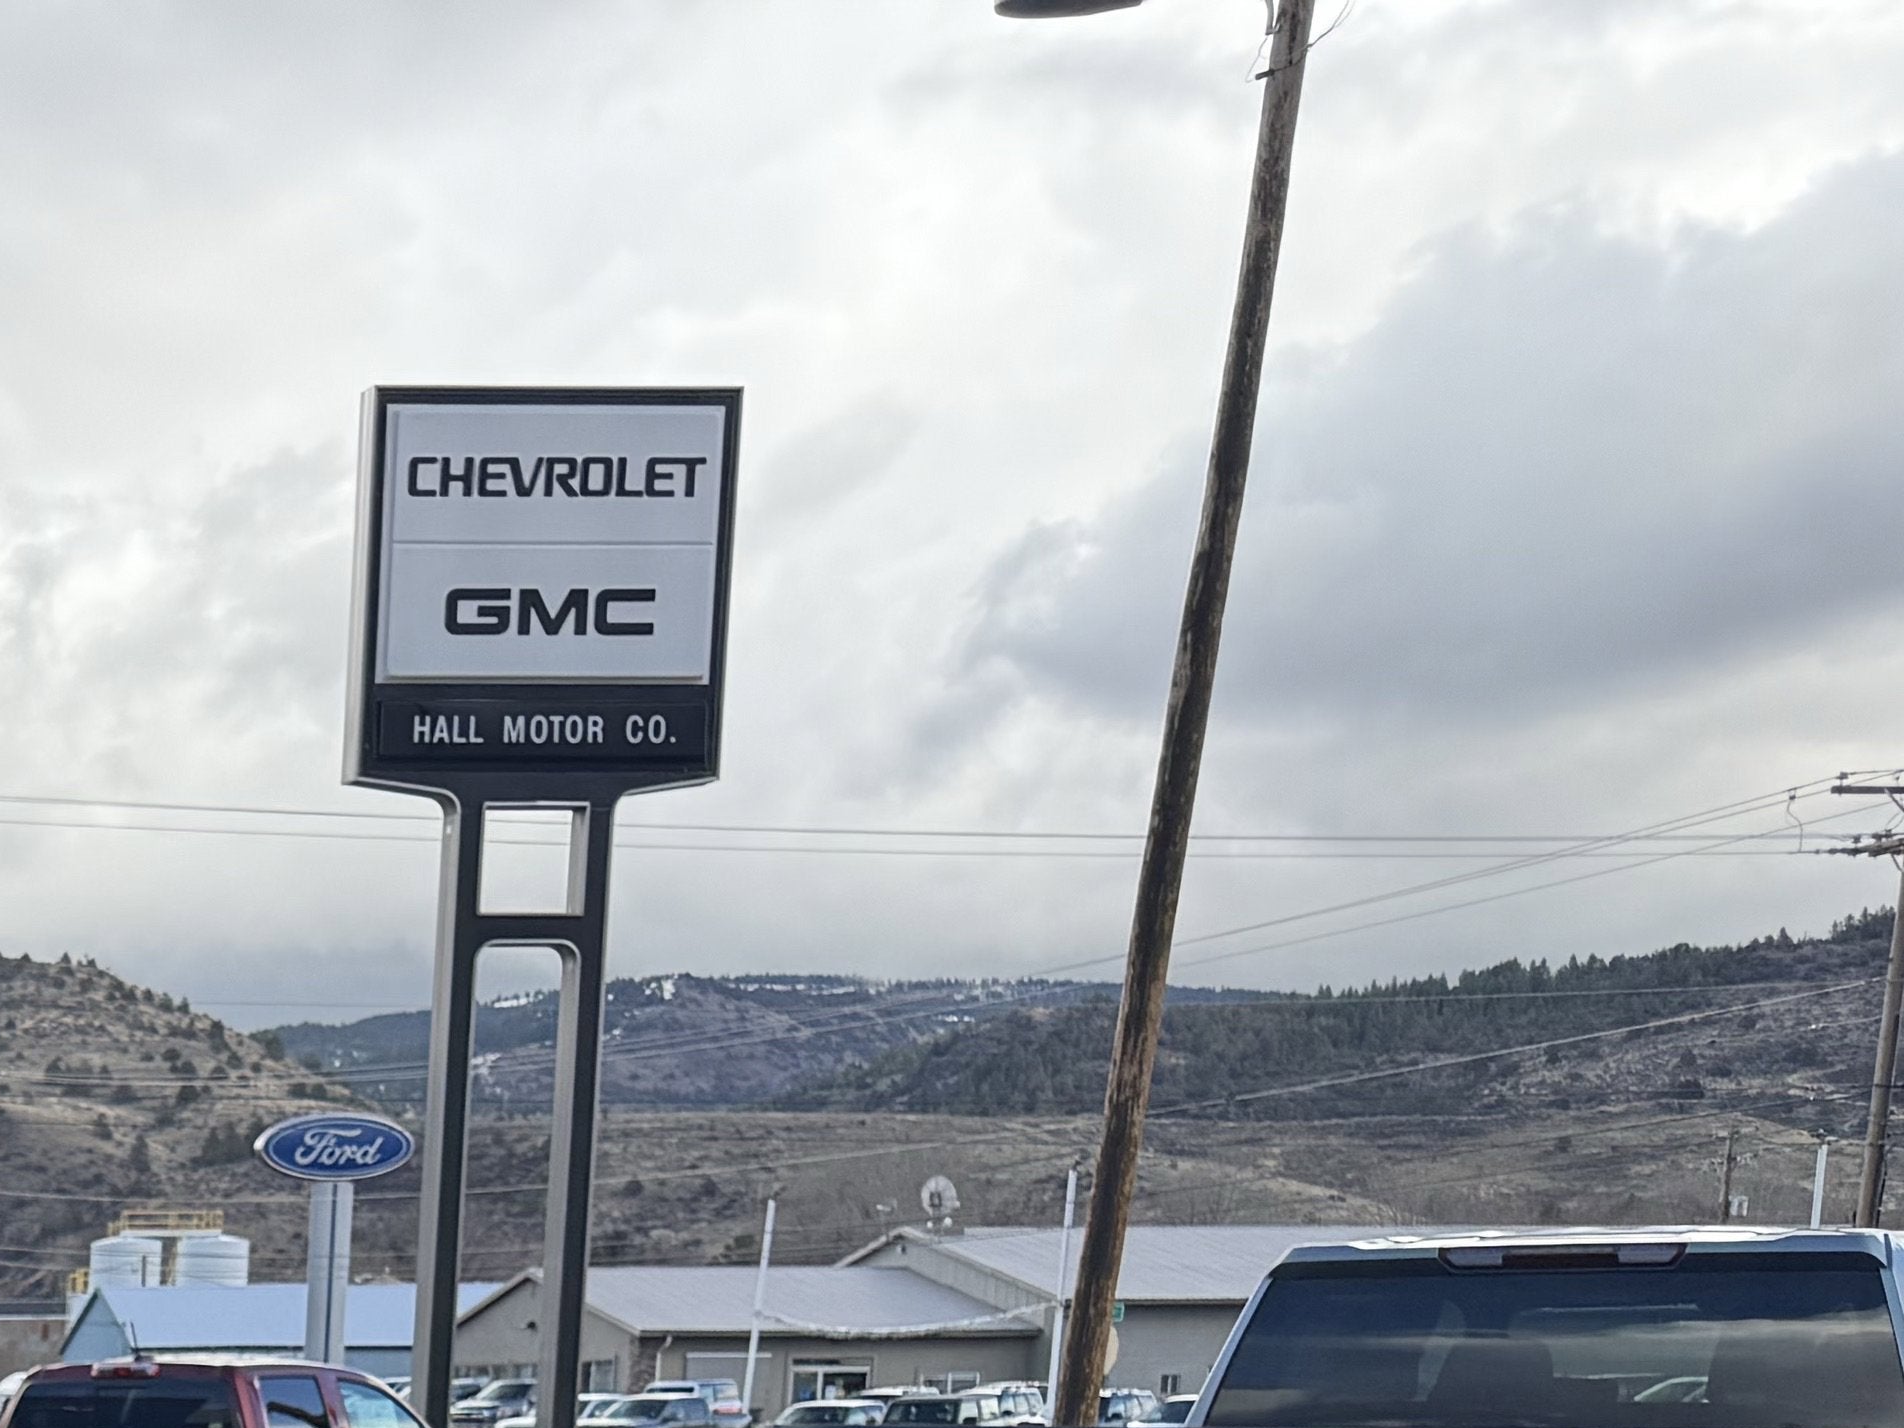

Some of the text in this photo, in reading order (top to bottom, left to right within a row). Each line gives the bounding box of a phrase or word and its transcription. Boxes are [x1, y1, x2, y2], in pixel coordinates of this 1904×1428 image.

[408, 456, 708, 498] CHEVROLET
[444, 588, 657, 637] GMC
[413, 714, 678, 744] HALL MOTOR CO.
[294, 1127, 384, 1166] Ford
